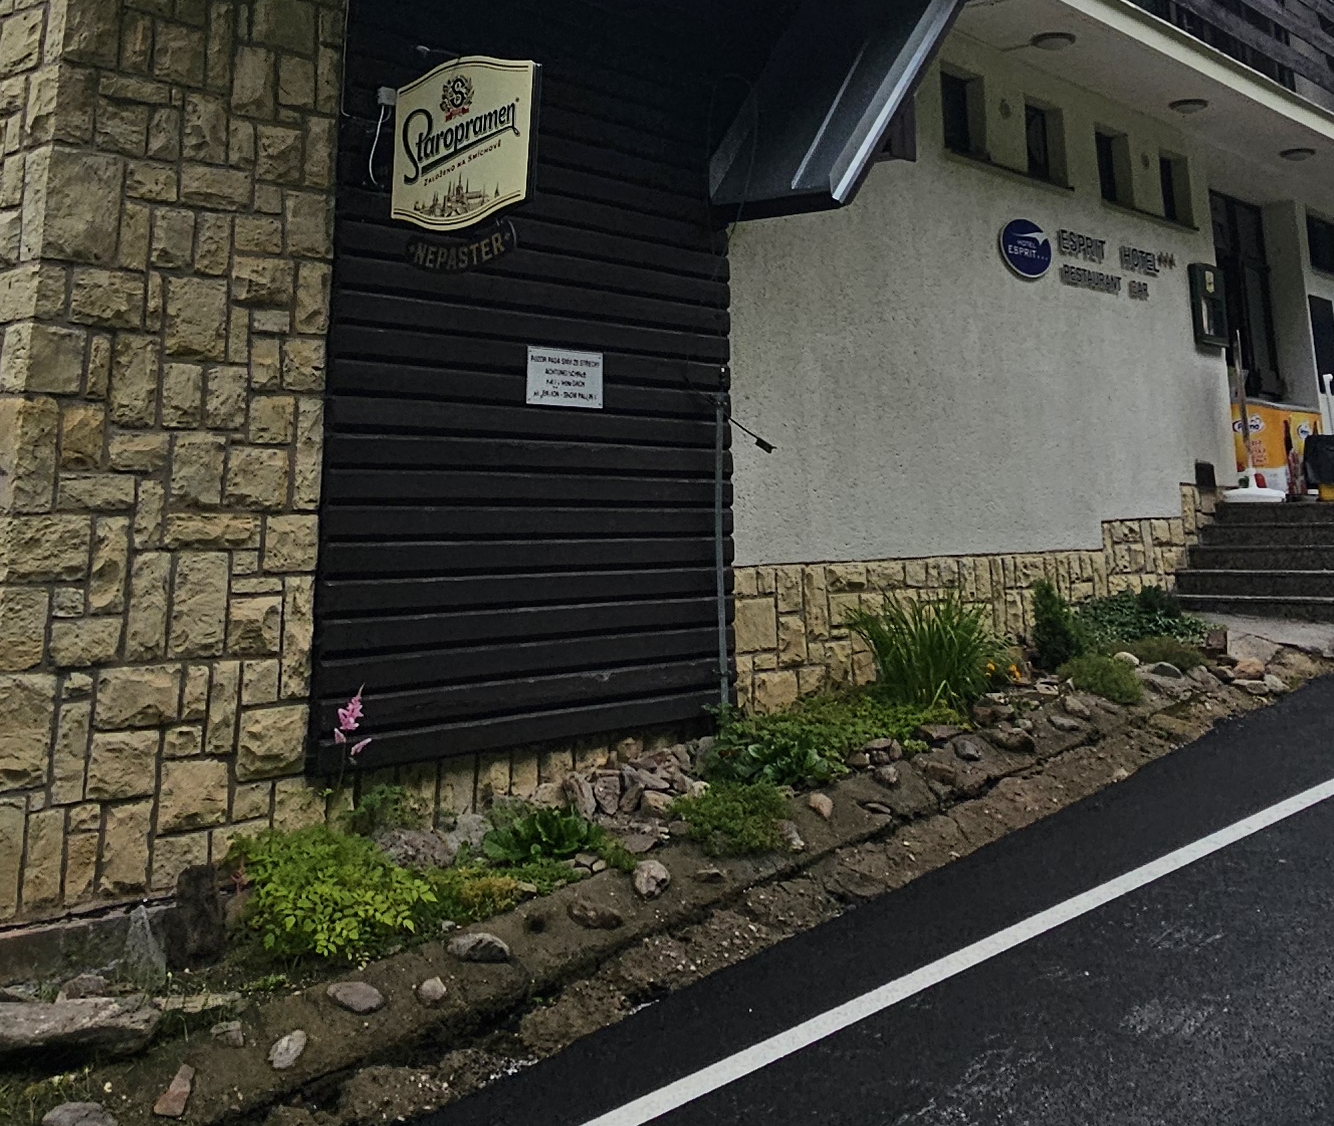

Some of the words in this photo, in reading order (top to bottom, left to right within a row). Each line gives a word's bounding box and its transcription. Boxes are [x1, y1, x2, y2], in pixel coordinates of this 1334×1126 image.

[402, 101, 517, 185] Staropramen
[413, 232, 505, 270] NEPASTER
[1016, 239, 1037, 249] HOTEL
[1058, 228, 1106, 262] ESPRIT
[1121, 245, 1160, 273] HOTEL
[1062, 263, 1122, 293] RESTAURANT
